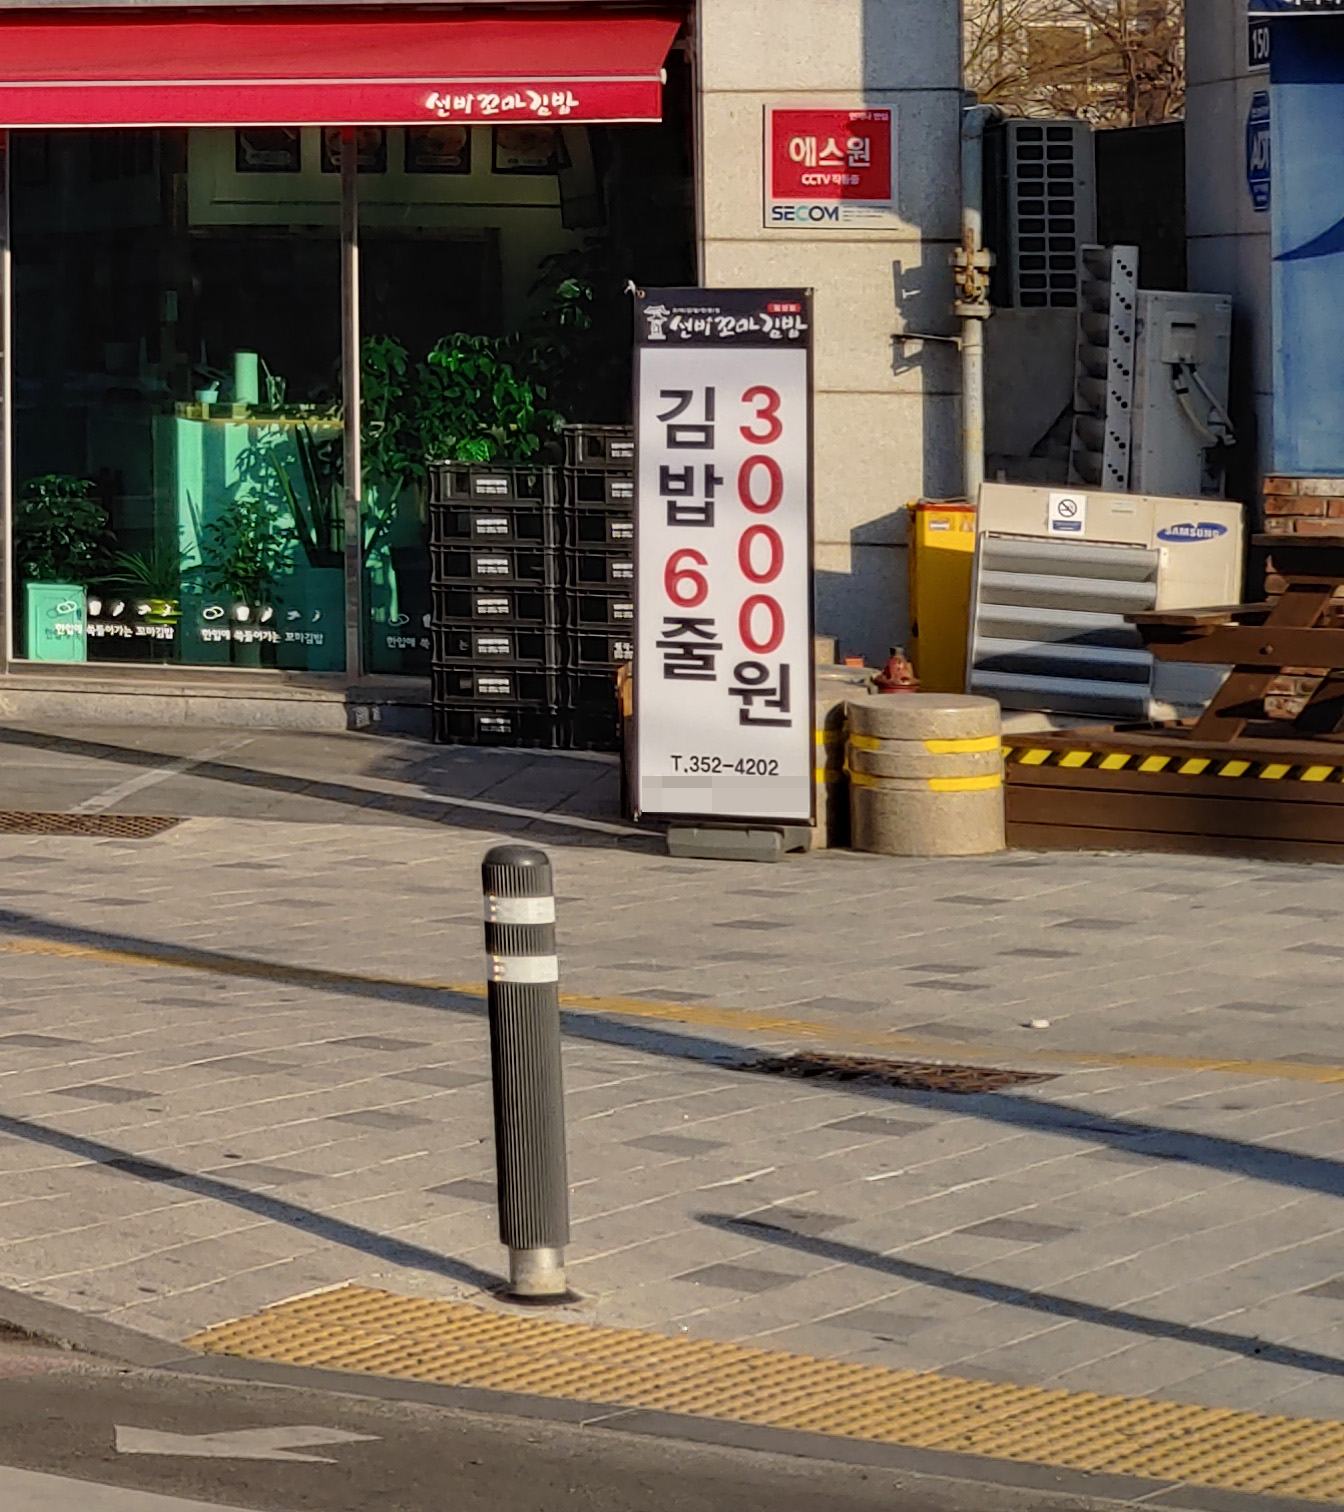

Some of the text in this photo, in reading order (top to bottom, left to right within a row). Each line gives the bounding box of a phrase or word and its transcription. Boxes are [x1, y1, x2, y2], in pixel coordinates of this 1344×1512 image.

[789, 136, 871, 168] 에스원
[801, 173, 831, 186] CCTV
[771, 205, 840, 222] SECOM
[671, 754, 780, 776] T.352-4202
